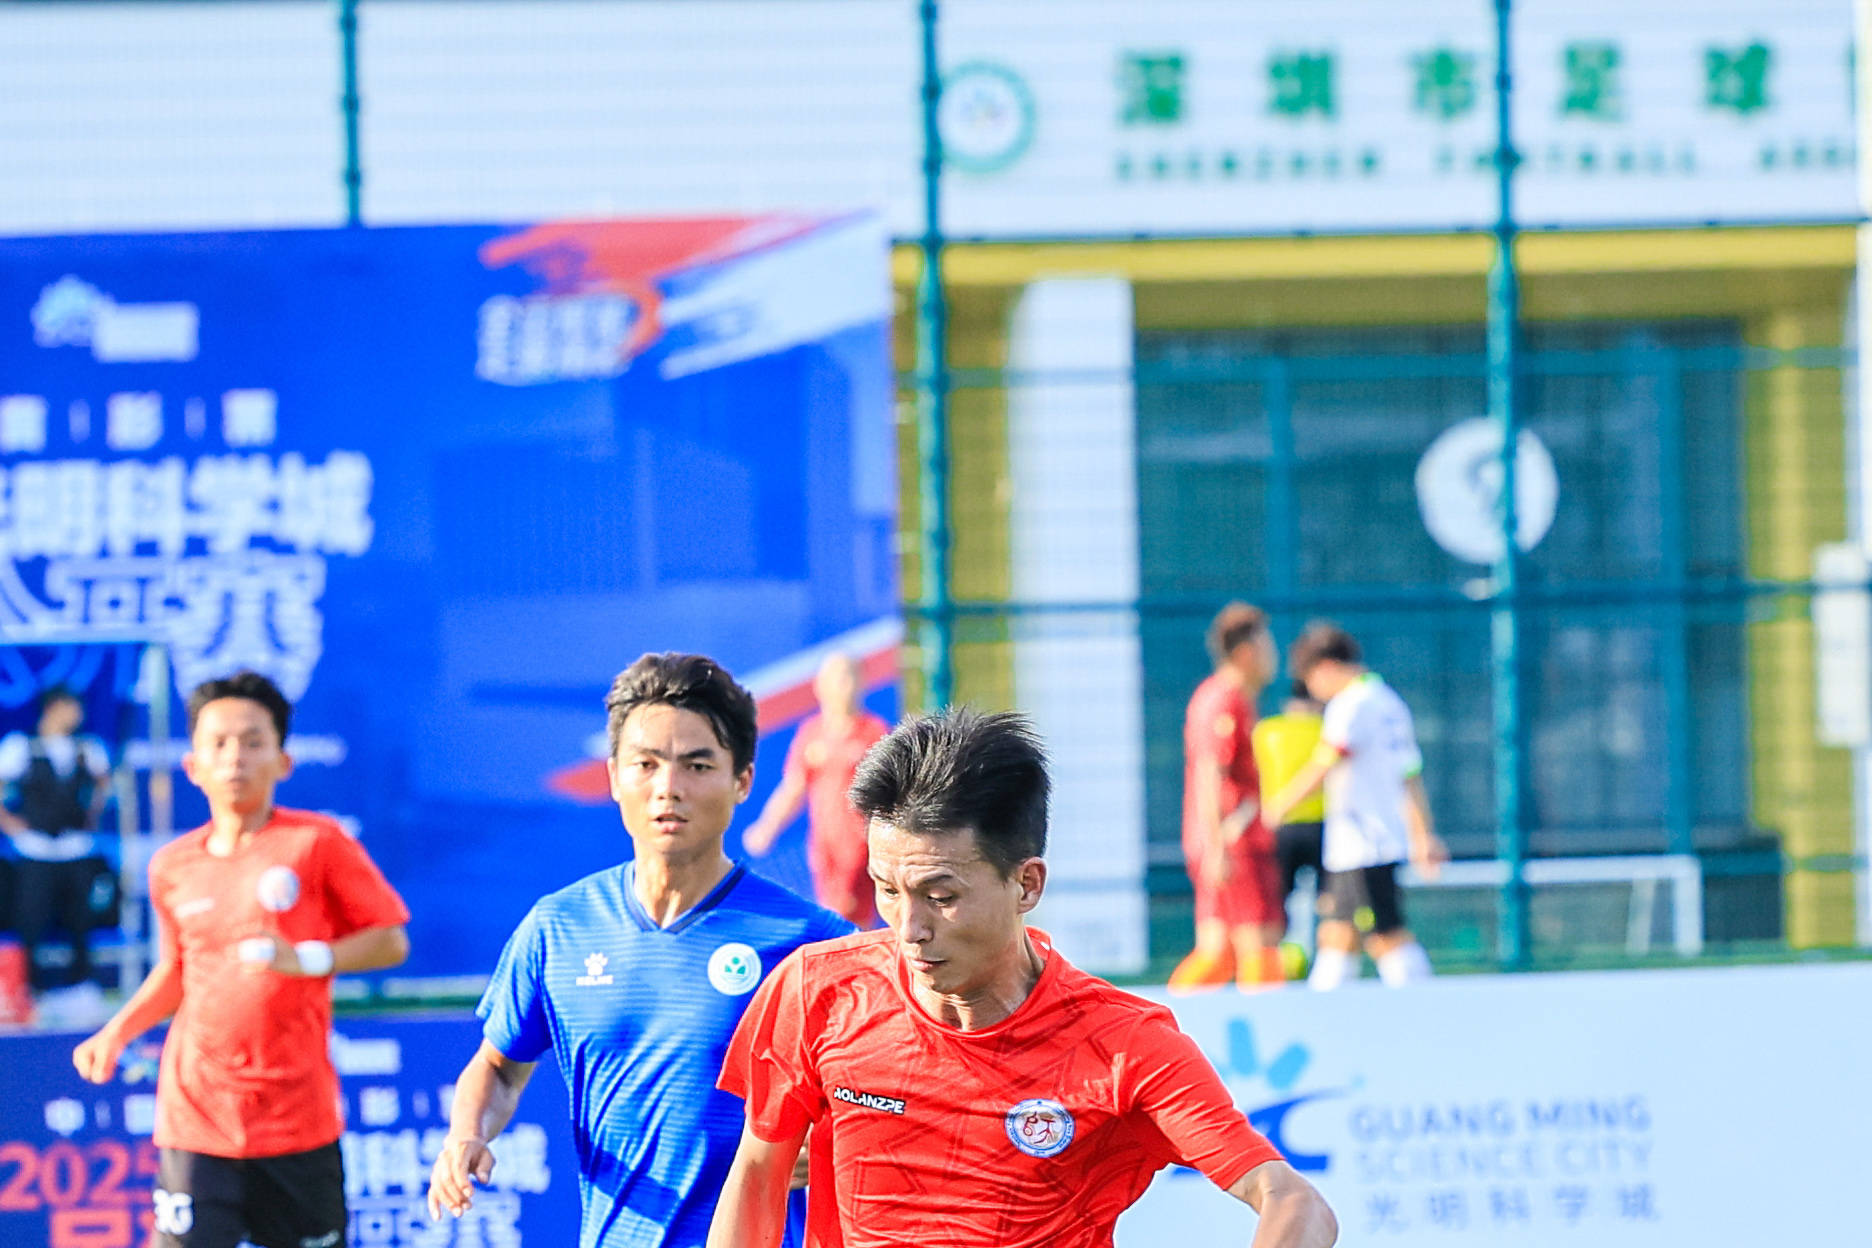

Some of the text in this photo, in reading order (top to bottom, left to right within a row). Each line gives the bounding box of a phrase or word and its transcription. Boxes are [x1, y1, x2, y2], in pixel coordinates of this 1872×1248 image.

[1116, 42, 1856, 127] 深圳市足球
[1349, 1095, 1652, 1142] GUANG MING
